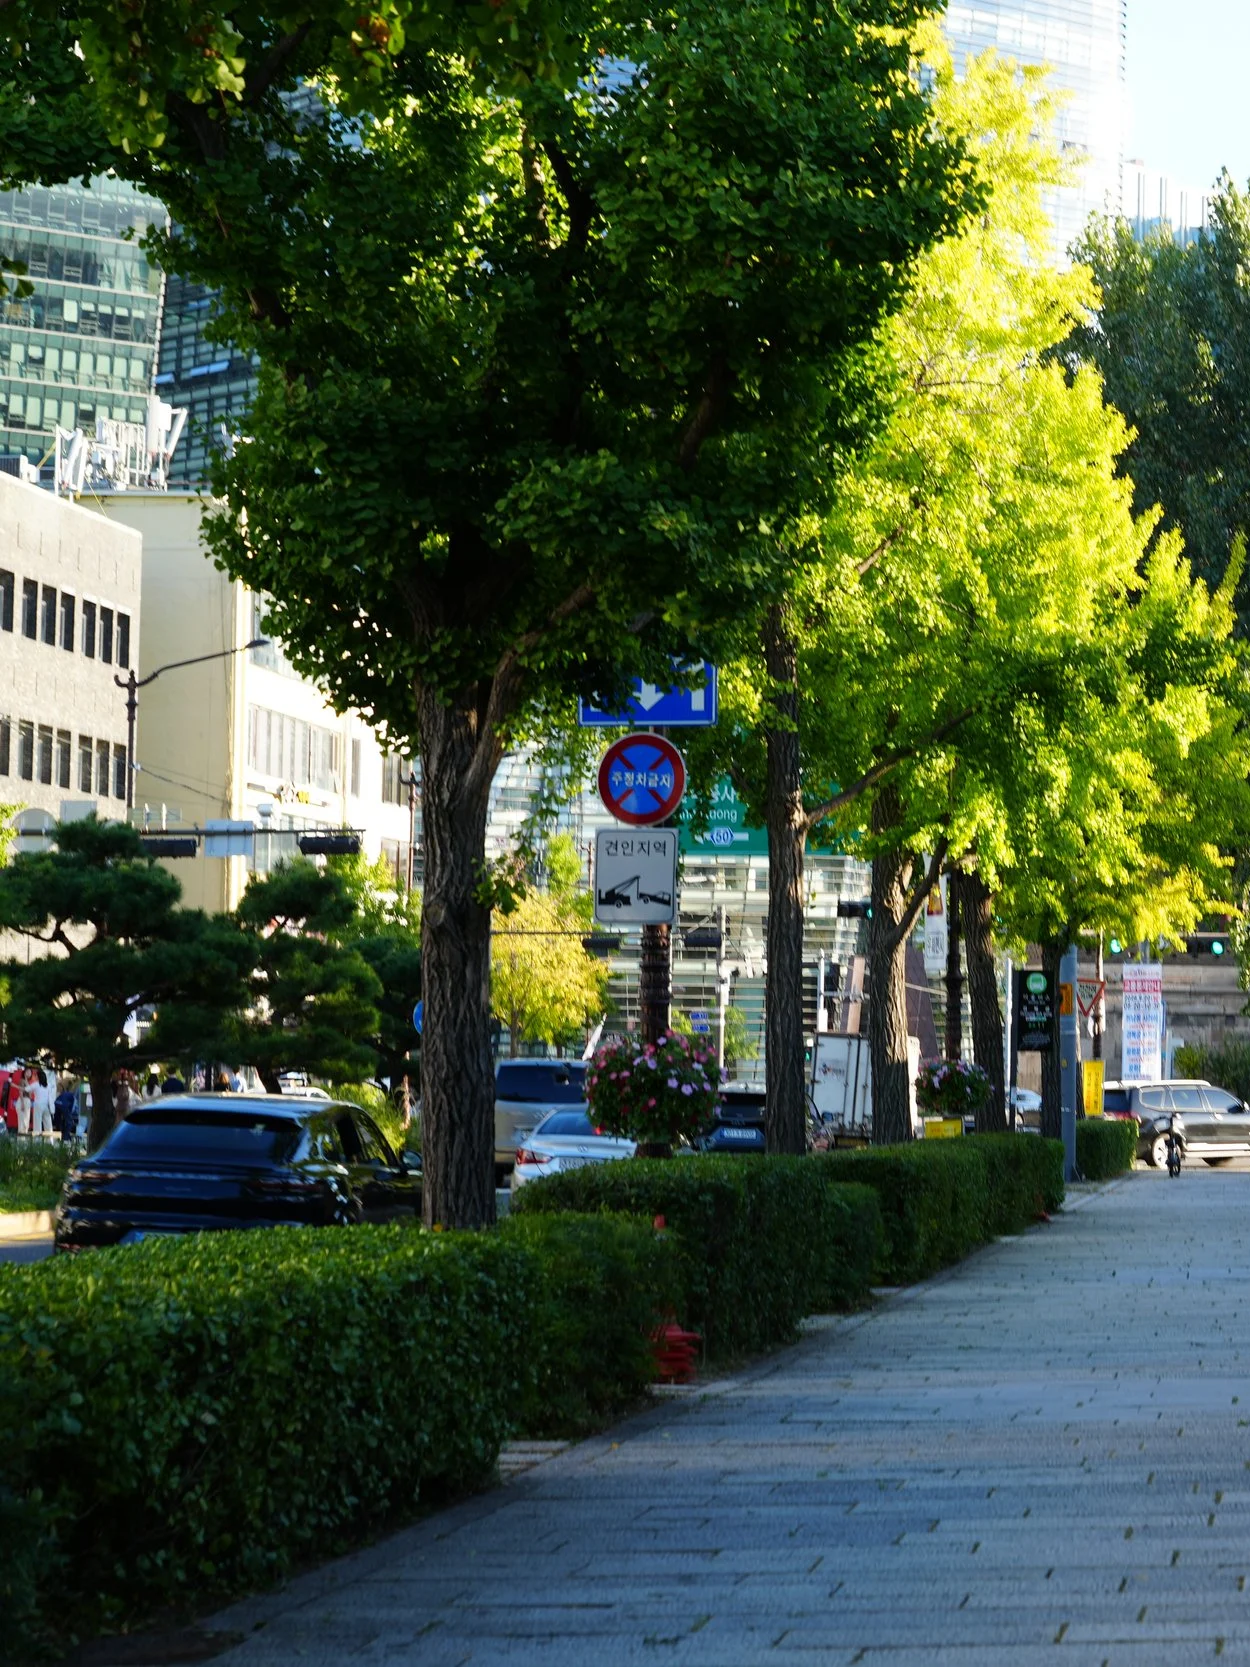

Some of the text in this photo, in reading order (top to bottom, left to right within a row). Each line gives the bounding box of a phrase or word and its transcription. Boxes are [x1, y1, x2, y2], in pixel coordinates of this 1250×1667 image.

[612, 771, 671, 788] 주정차금지
[715, 830, 730, 844] 50
[605, 839, 667, 857] 견인지역
